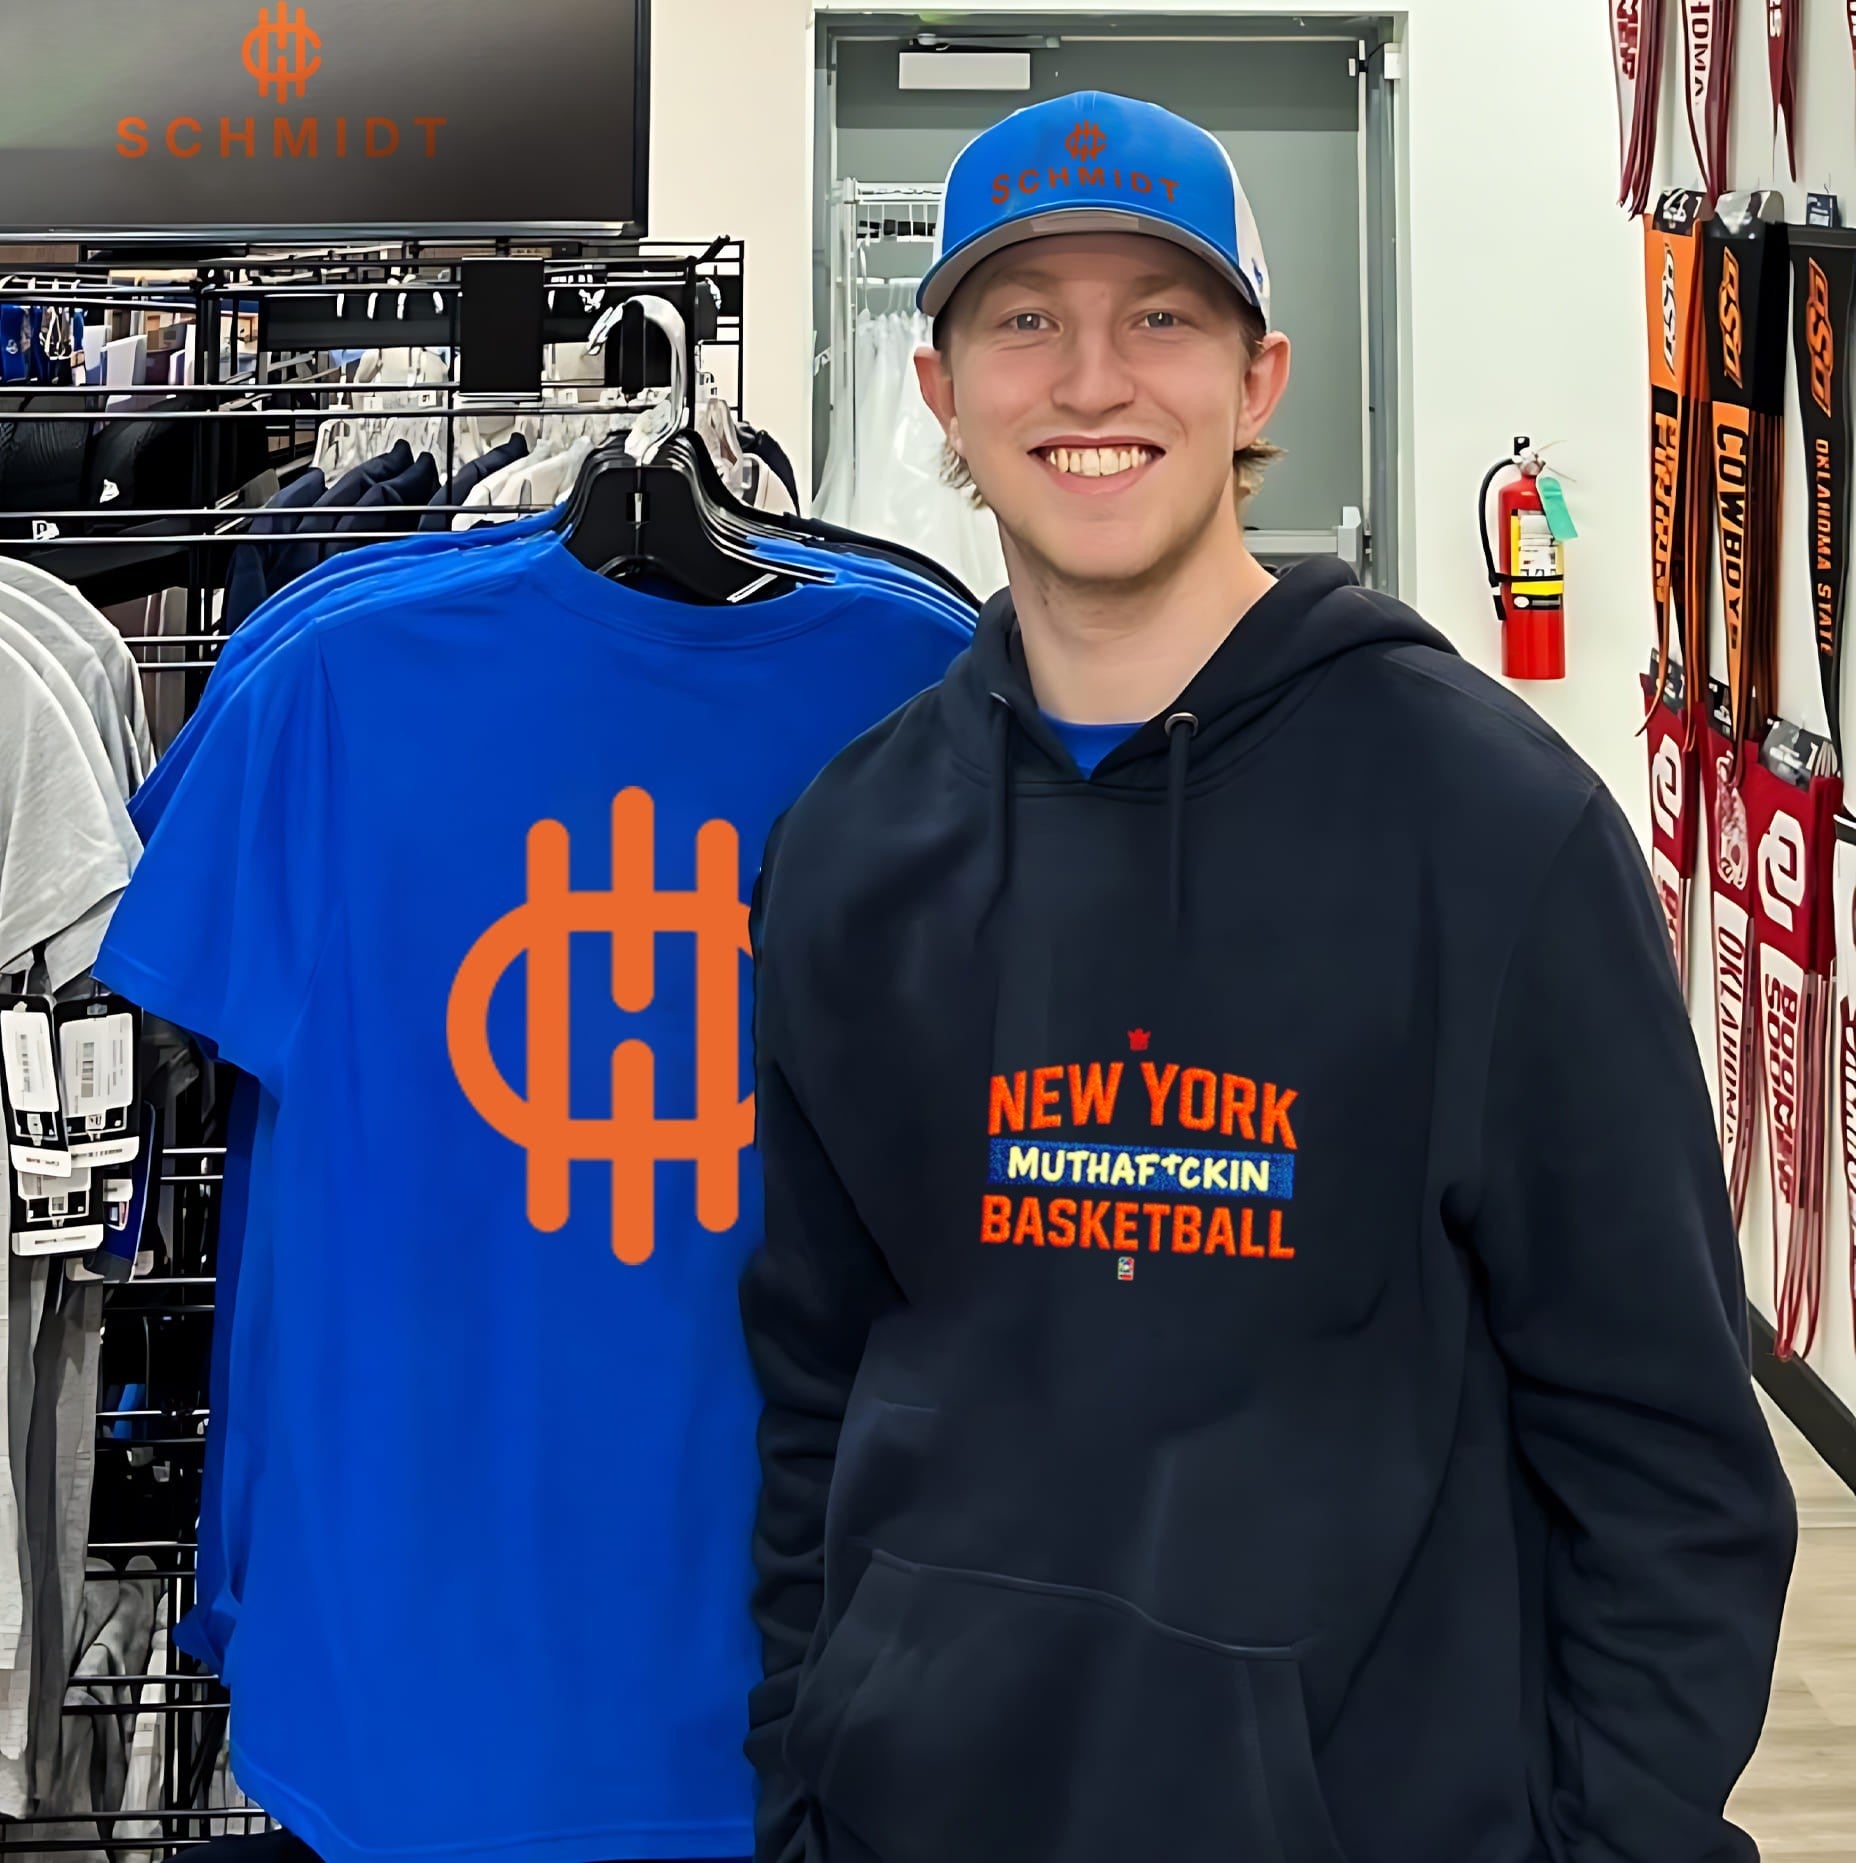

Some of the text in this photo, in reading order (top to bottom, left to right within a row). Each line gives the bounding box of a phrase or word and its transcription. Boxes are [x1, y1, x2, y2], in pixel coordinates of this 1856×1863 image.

[116, 116, 448, 159] SCHMIDT
[991, 167, 1180, 204] SCHMIDT
[1815, 438, 1832, 571] OKLAHOMA
[987, 1061, 1299, 1150] NEW YORK
[979, 1194, 1296, 1260] BASKETBALL
